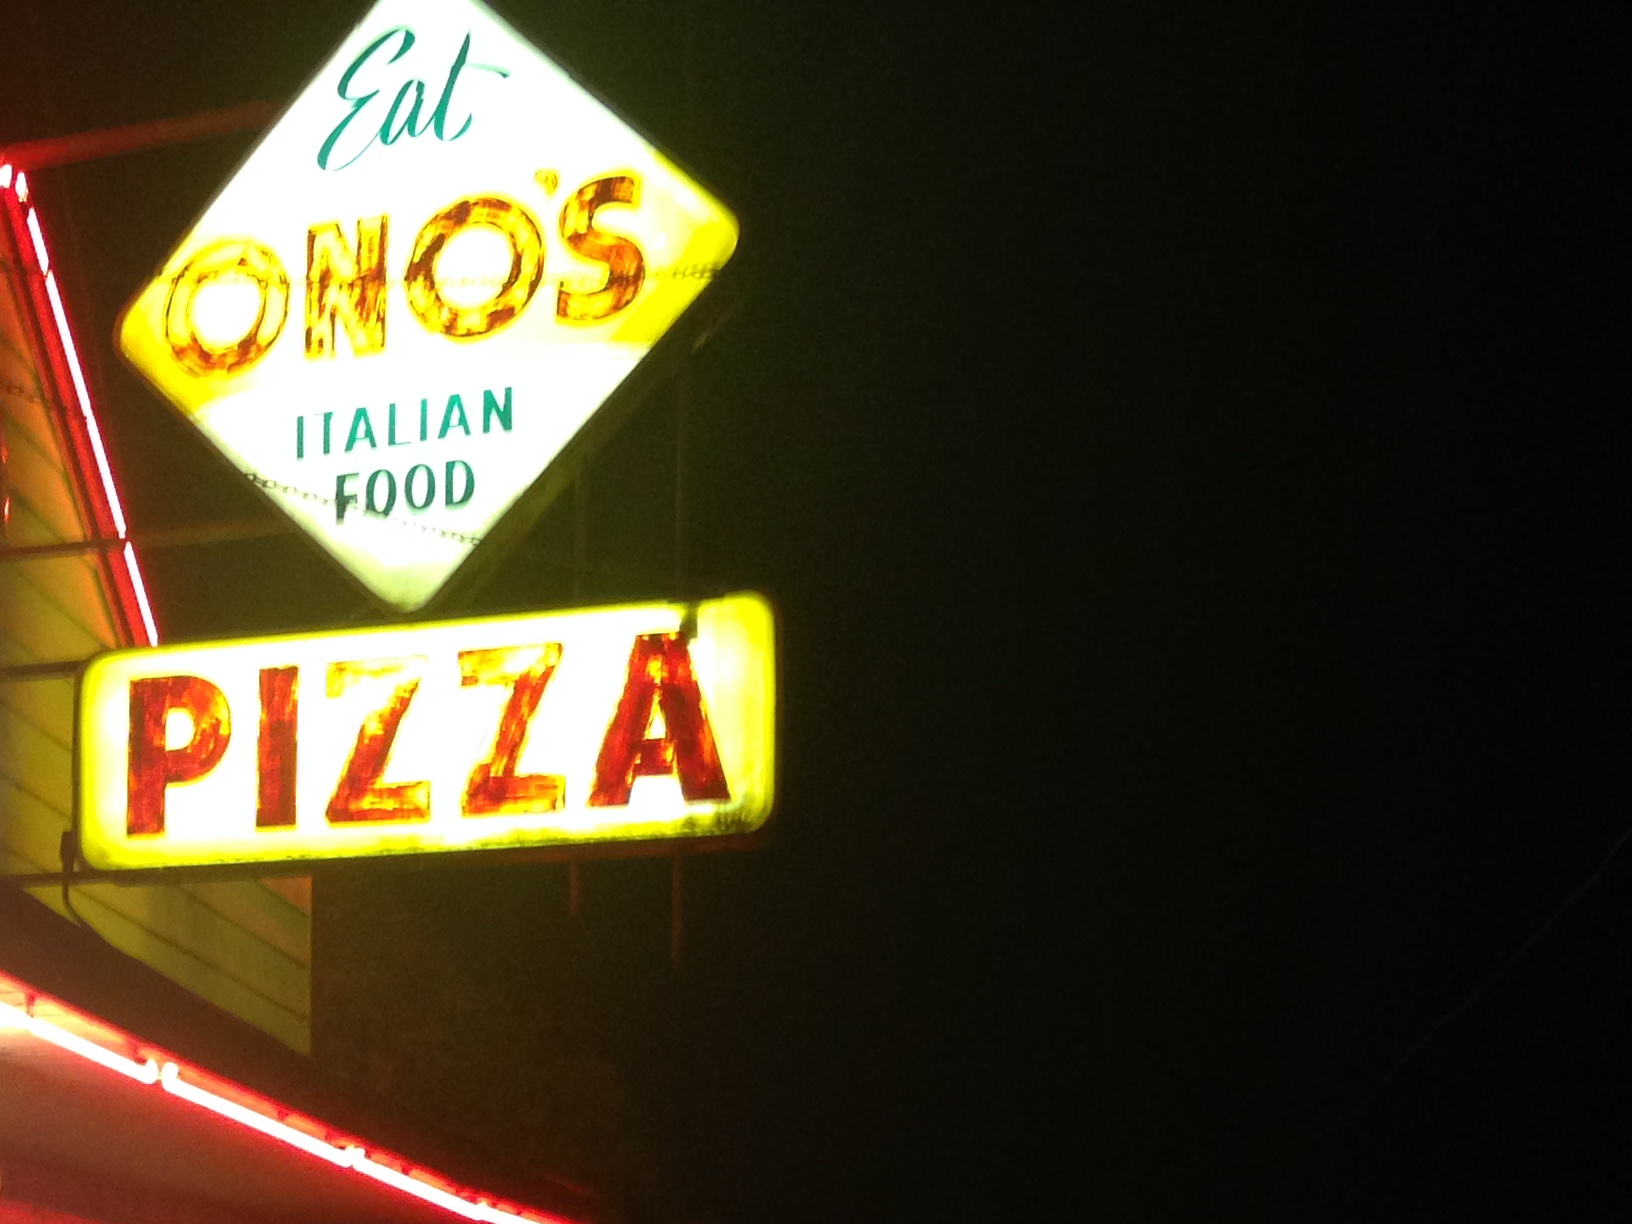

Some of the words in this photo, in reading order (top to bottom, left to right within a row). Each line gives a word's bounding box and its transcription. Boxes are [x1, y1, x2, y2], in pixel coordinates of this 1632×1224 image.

[316, 26, 510, 171] Eat
[163, 168, 647, 378] ONO'S
[295, 387, 514, 460] ITALIAN
[333, 459, 476, 525] FOOD
[126, 631, 732, 838] PIZZA
